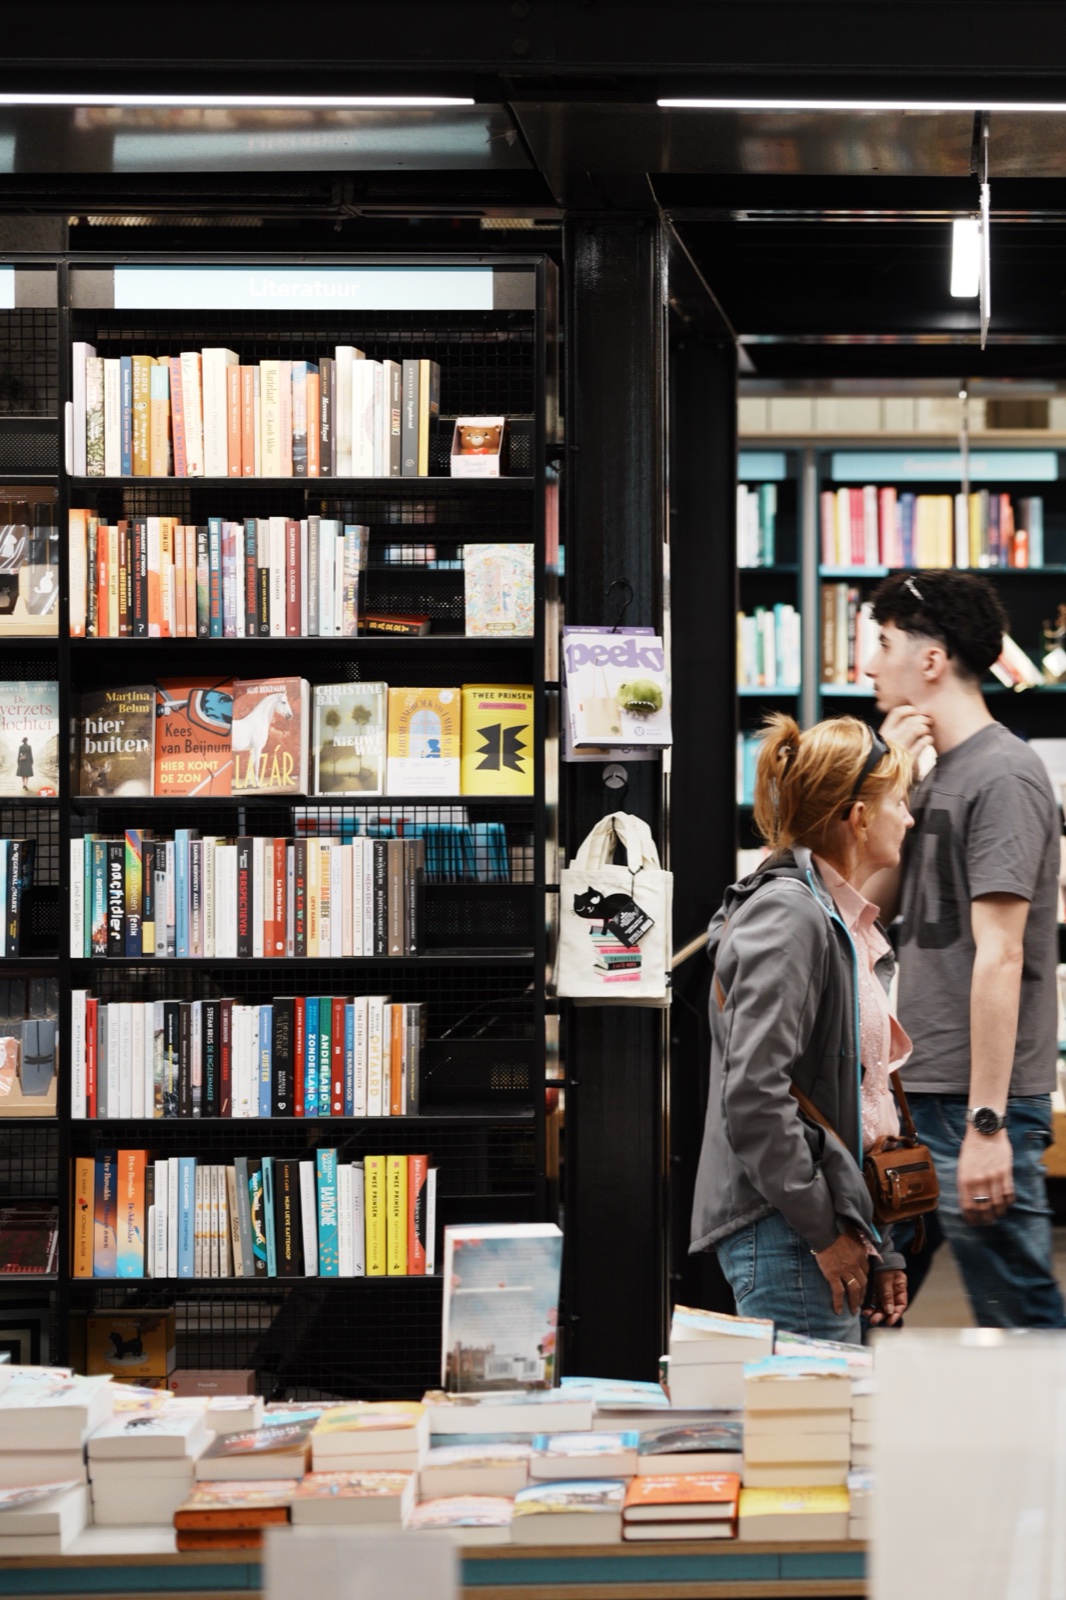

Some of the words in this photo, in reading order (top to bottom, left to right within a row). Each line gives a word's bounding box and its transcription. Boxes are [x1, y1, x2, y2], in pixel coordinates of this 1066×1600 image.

[249, 277, 359, 299] Literatuur
[141, 367, 149, 393] KADER
[266, 369, 277, 405] Martelaar!
[135, 572, 141, 580] DE
[106, 691, 150, 702] Martina
[316, 684, 383, 696] CHRISTINE
[498, 692, 533, 700] PRINSEN
[118, 703, 150, 713] Behm
[84, 717, 125, 735] hier
[165, 723, 192, 738] Kees
[84, 736, 150, 754] buiten
[161, 744, 181, 754] van
[184, 739, 231, 756] Beijnum
[161, 762, 185, 772] HIER
[187, 761, 219, 771] KOMT
[161, 774, 174, 784] DE
[177, 773, 202, 783] ZON
[239, 871, 247, 936] PERSPECTIEVEN
[73, 911, 82, 932] Johan
[127, 914, 140, 936] fenix
[207, 1045, 214, 1053] DE
[308, 1033, 316, 1101] ZONDERLAND
[320, 1033, 330, 1101] ANDERLAND
[370, 1035, 380, 1097] ONTAARD
